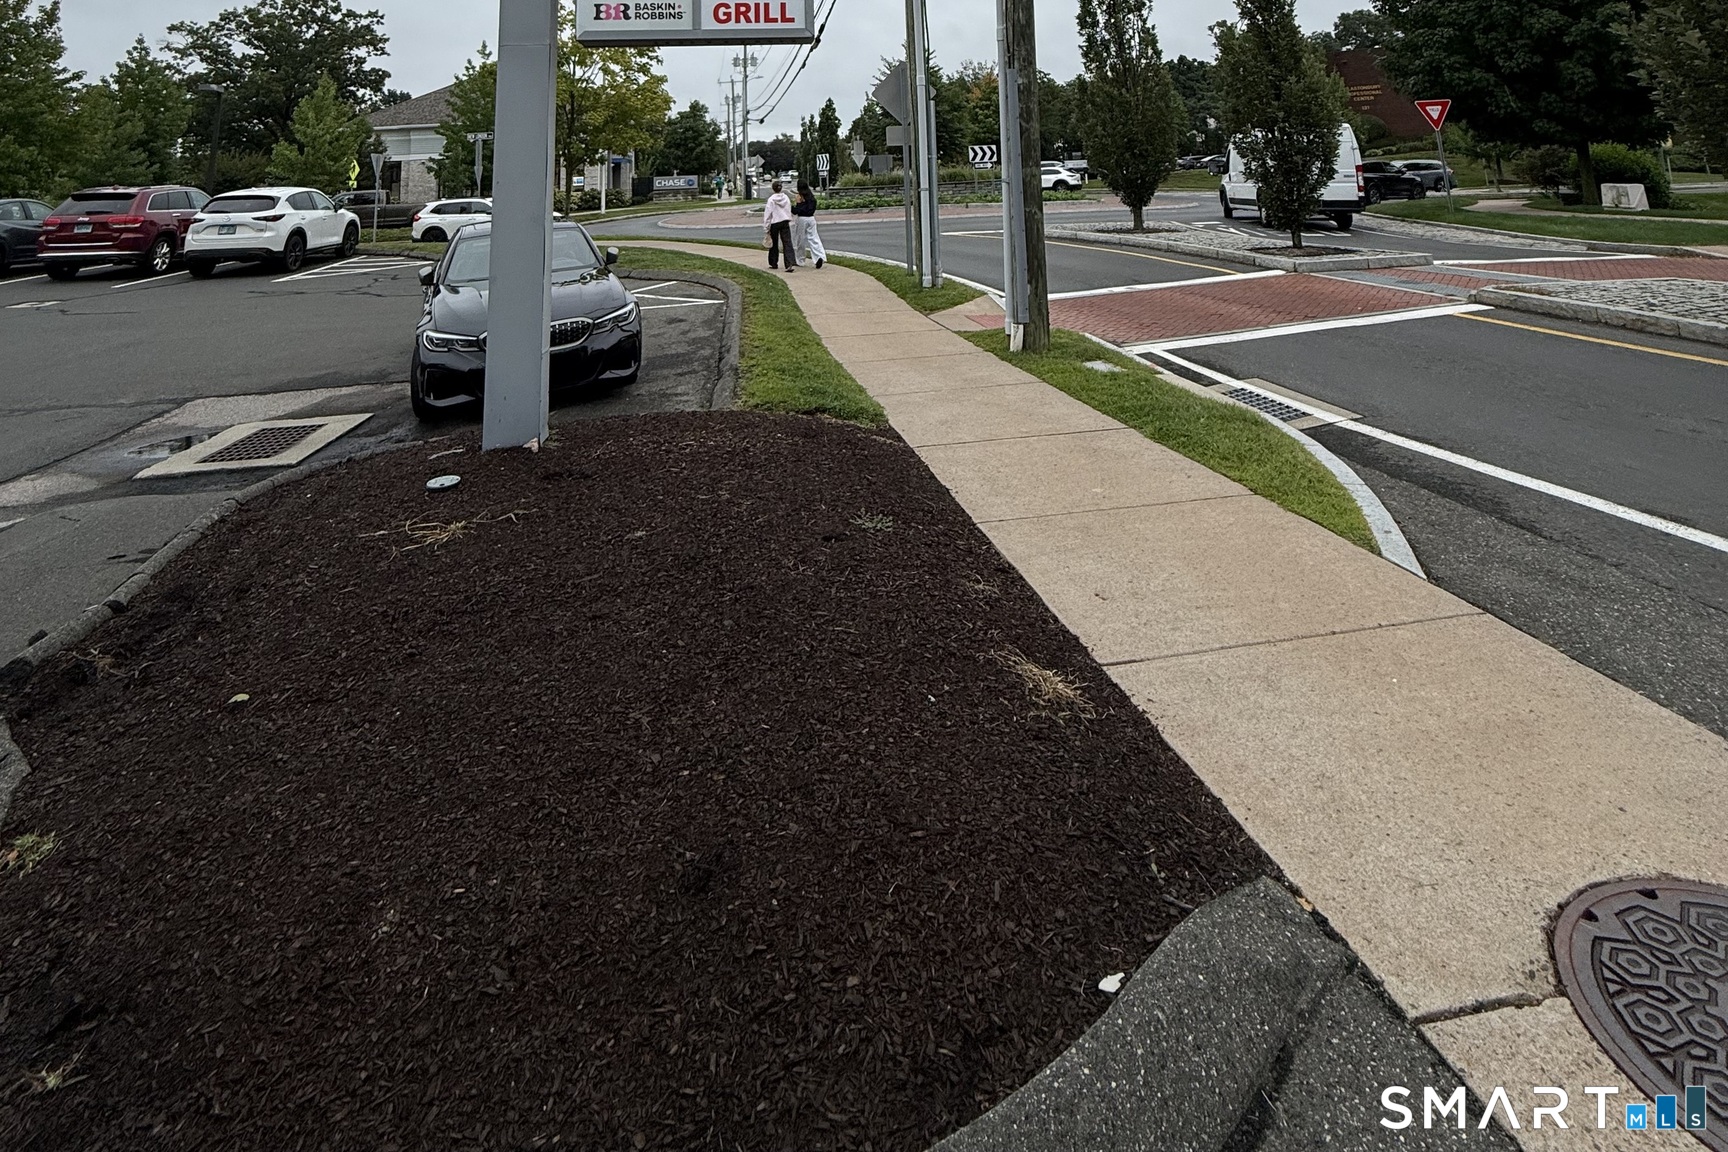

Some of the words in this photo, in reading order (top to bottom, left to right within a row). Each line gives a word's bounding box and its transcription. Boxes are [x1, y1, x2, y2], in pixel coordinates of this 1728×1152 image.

[634, 2, 677, 11] BASKIN
[634, 11, 684, 20] ROBBINS
[713, 2, 795, 24] GRILL
[655, 178, 686, 187] CHASE
